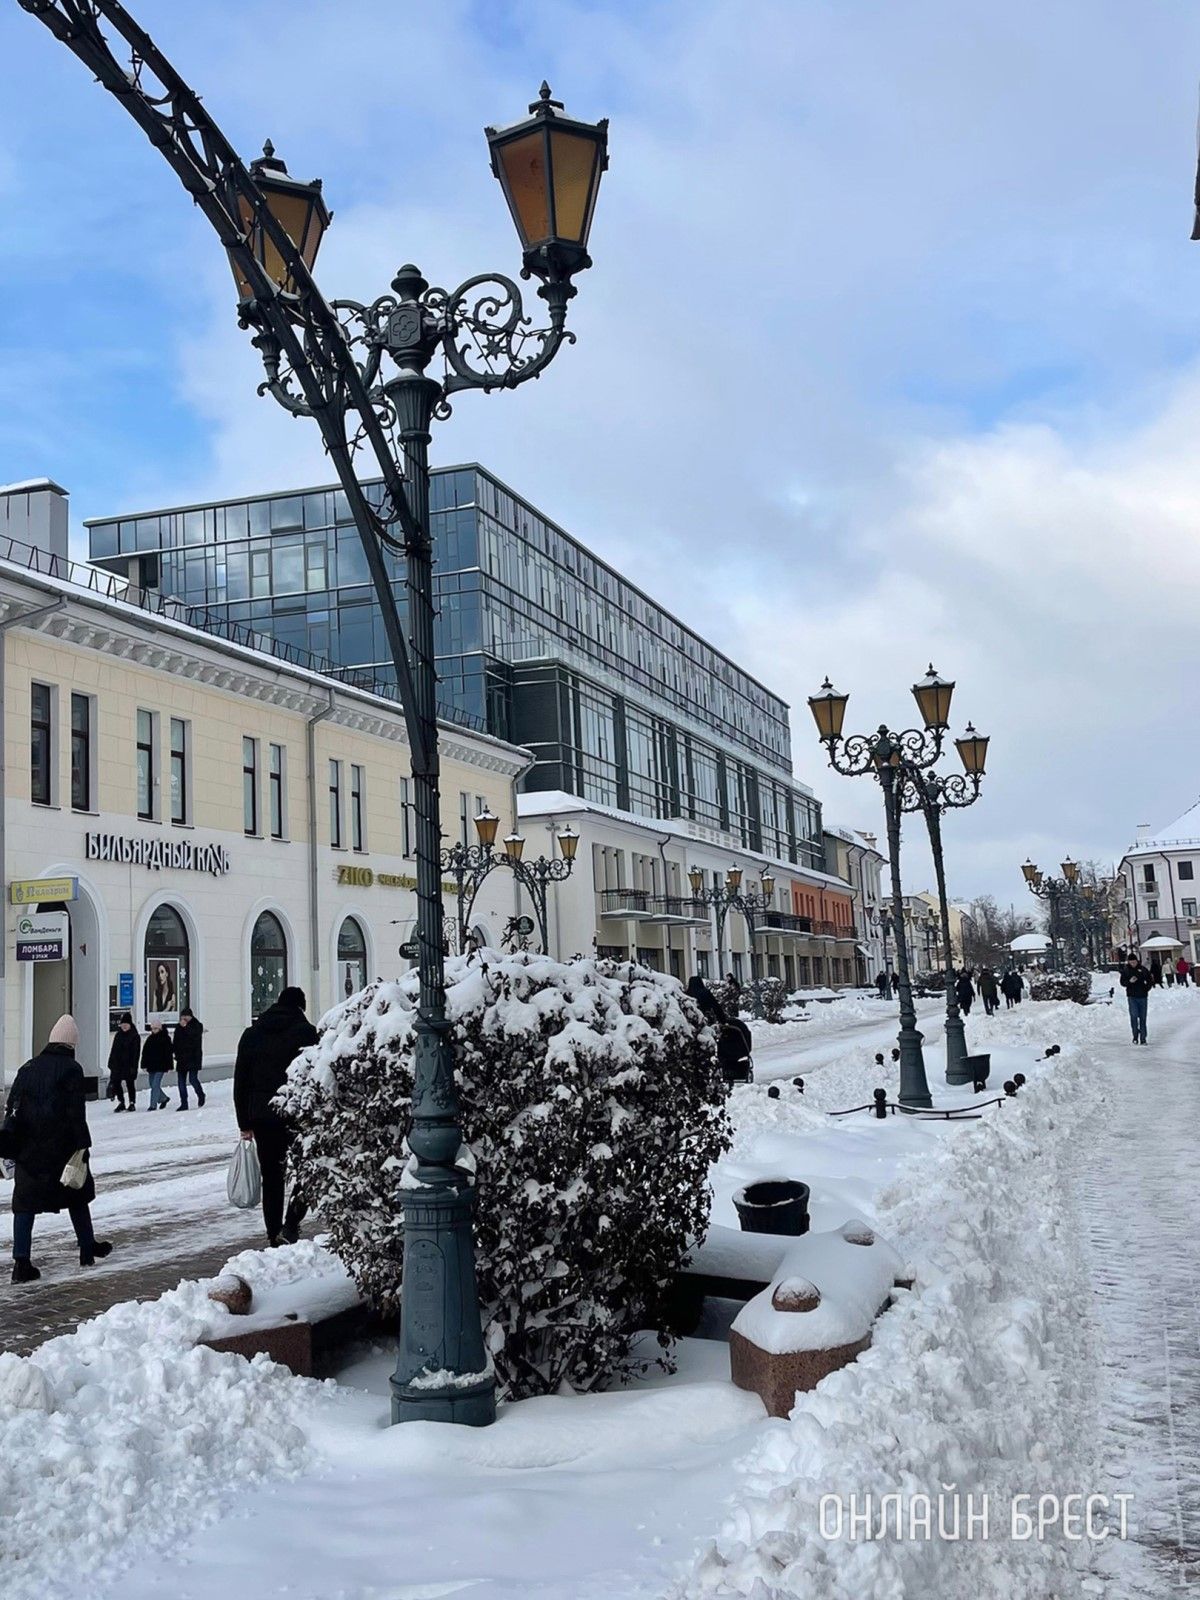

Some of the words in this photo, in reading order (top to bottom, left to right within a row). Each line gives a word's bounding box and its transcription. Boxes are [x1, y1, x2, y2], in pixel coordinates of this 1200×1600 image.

[86, 832, 193, 870] БИЛЬЯРДНЫЙ
[195, 843, 231, 876] КЛУБ
[22, 944, 58, 954] ЛОМБАРД
